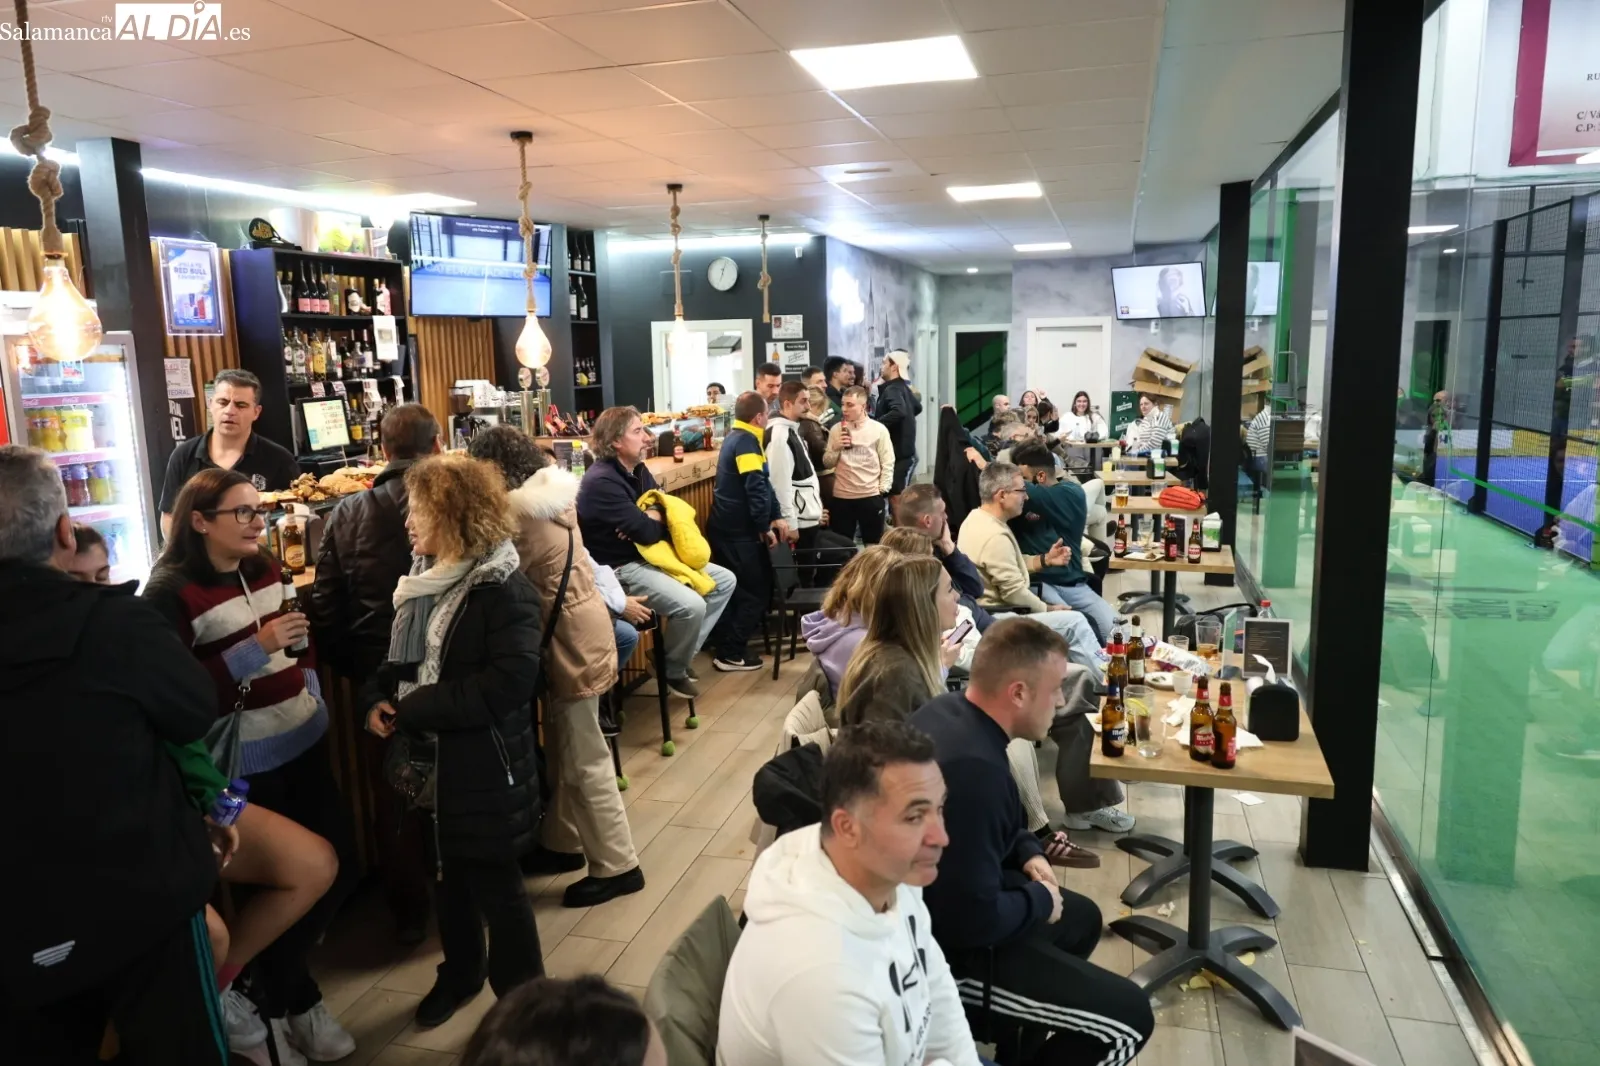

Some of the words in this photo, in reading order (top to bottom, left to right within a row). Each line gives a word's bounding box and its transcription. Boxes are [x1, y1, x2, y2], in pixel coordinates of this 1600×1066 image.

[1576, 111, 1588, 120] C/
[173, 266, 188, 275] RED
[189, 267, 207, 276] BULL
